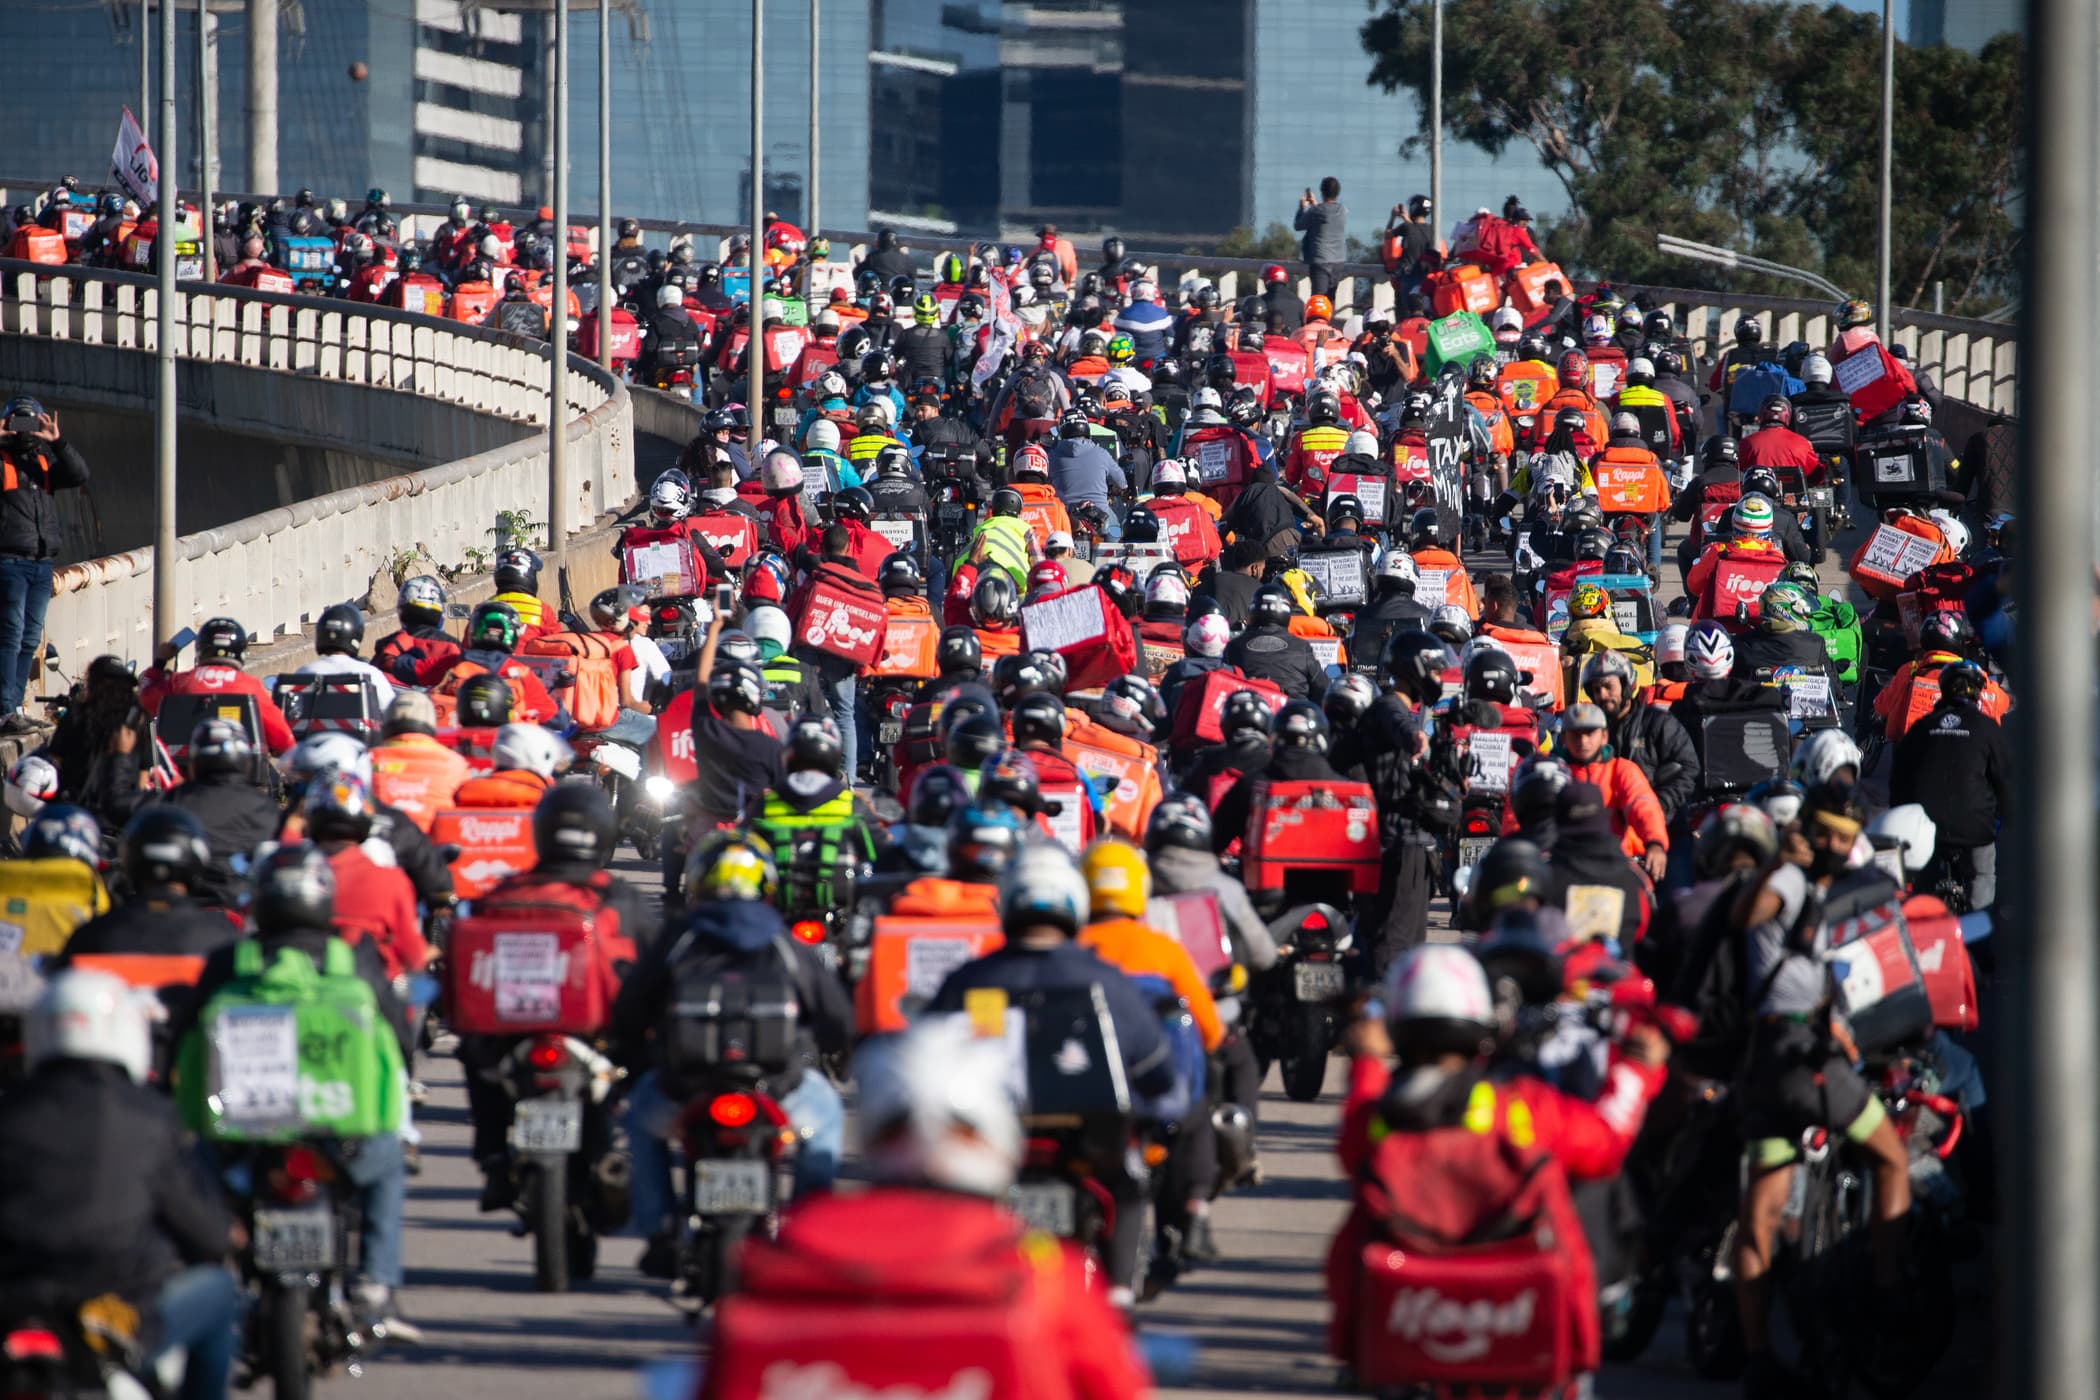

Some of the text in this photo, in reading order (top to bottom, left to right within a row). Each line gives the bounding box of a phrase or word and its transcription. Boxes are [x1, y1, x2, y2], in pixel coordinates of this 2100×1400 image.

[1440, 332, 1481, 352] Eats
[1402, 455, 1430, 472] ifoo
[1612, 468, 1647, 482] Rappi
[701, 530, 745, 549] food
[815, 594, 834, 607] QUER
[833, 601, 844, 610] UM
[460, 816, 522, 843] Rappi
